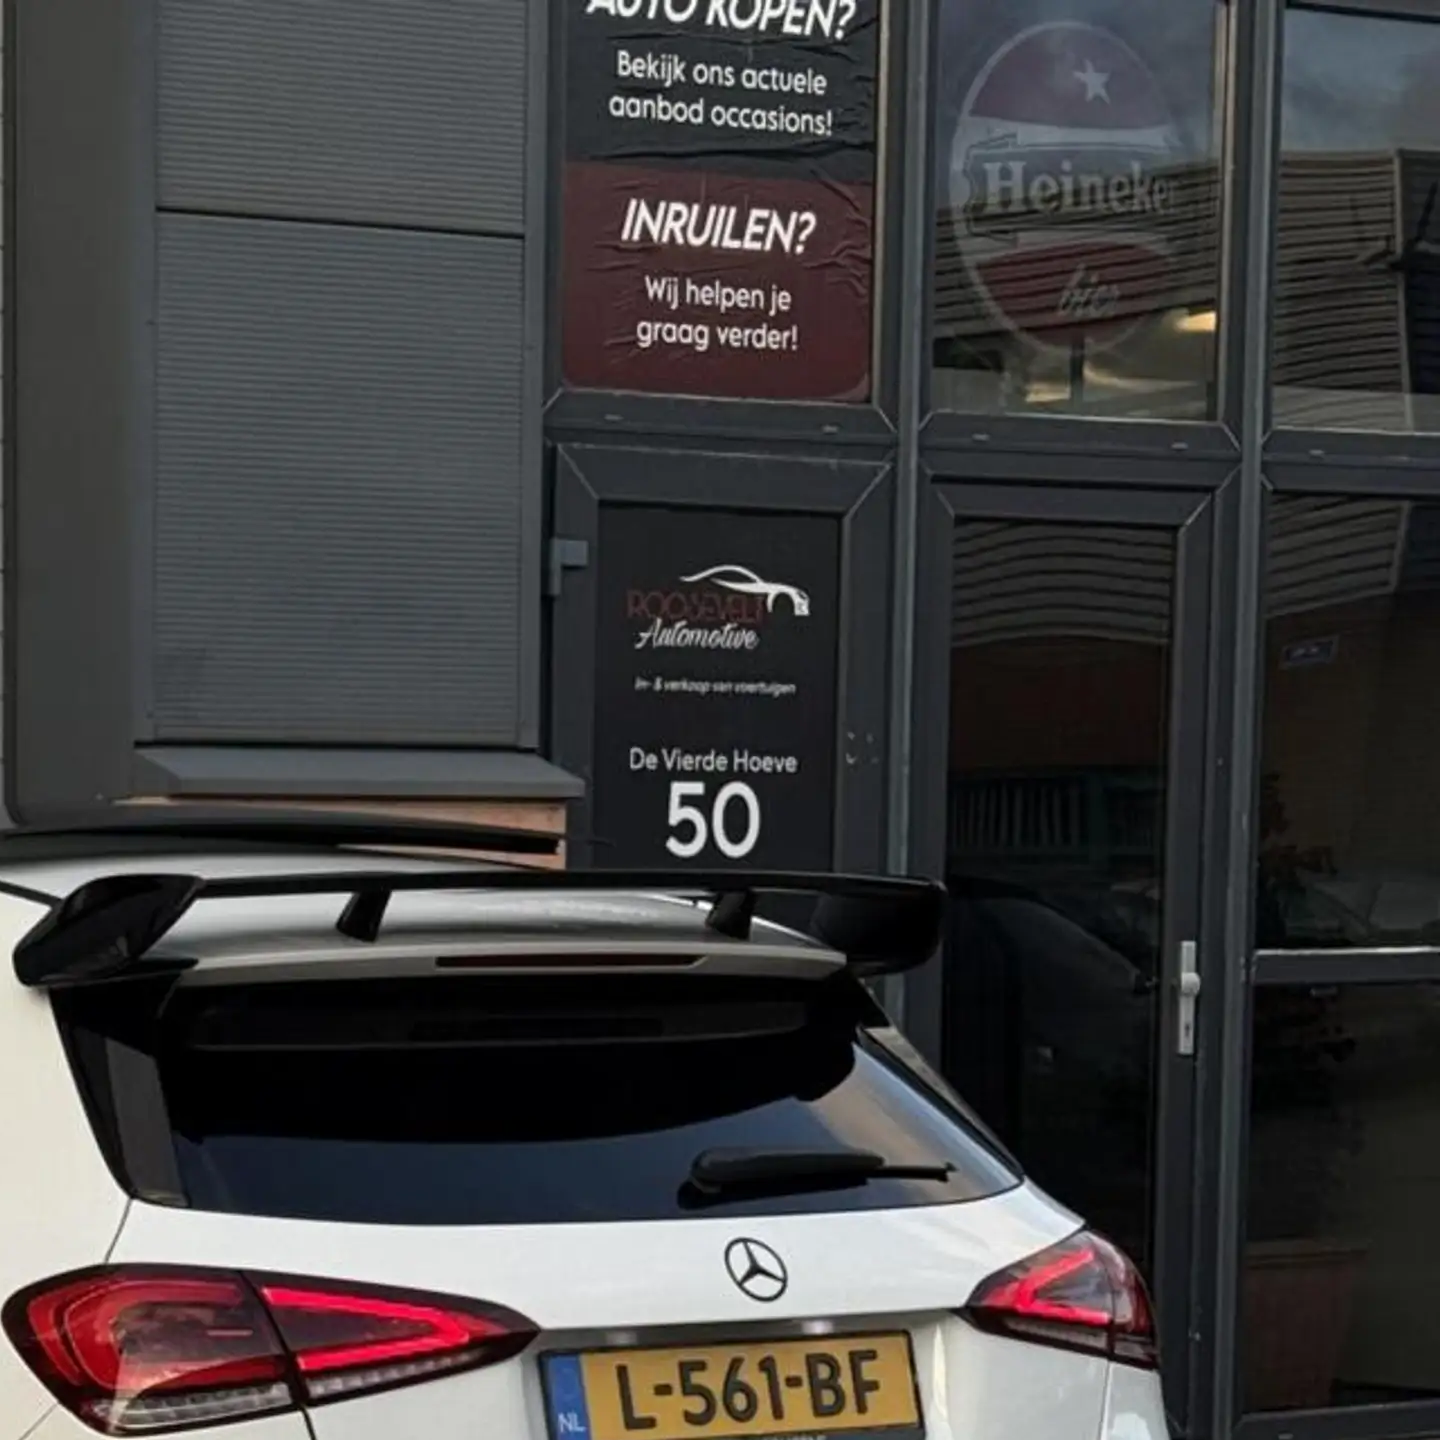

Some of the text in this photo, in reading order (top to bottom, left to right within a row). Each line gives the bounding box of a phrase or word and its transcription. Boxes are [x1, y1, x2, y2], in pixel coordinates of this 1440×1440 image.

[705, 0, 857, 40] KOPEN?
[617, 51, 828, 95] Bekijk ons actuele
[609, 95, 833, 136] aanbod occasions!
[982, 159, 1176, 215] Heineke
[621, 198, 817, 255] INRUILEN?
[645, 275, 792, 316] Wij helpen je
[636, 321, 798, 351] graag verder!
[626, 589, 766, 624] ROOSEVELT
[634, 617, 760, 650] Automotive
[629, 747, 798, 773] De Vierde Hoeve
[665, 780, 761, 859] 50
[615, 1348, 880, 1432] L-561-BF
[559, 1413, 586, 1434] NL
